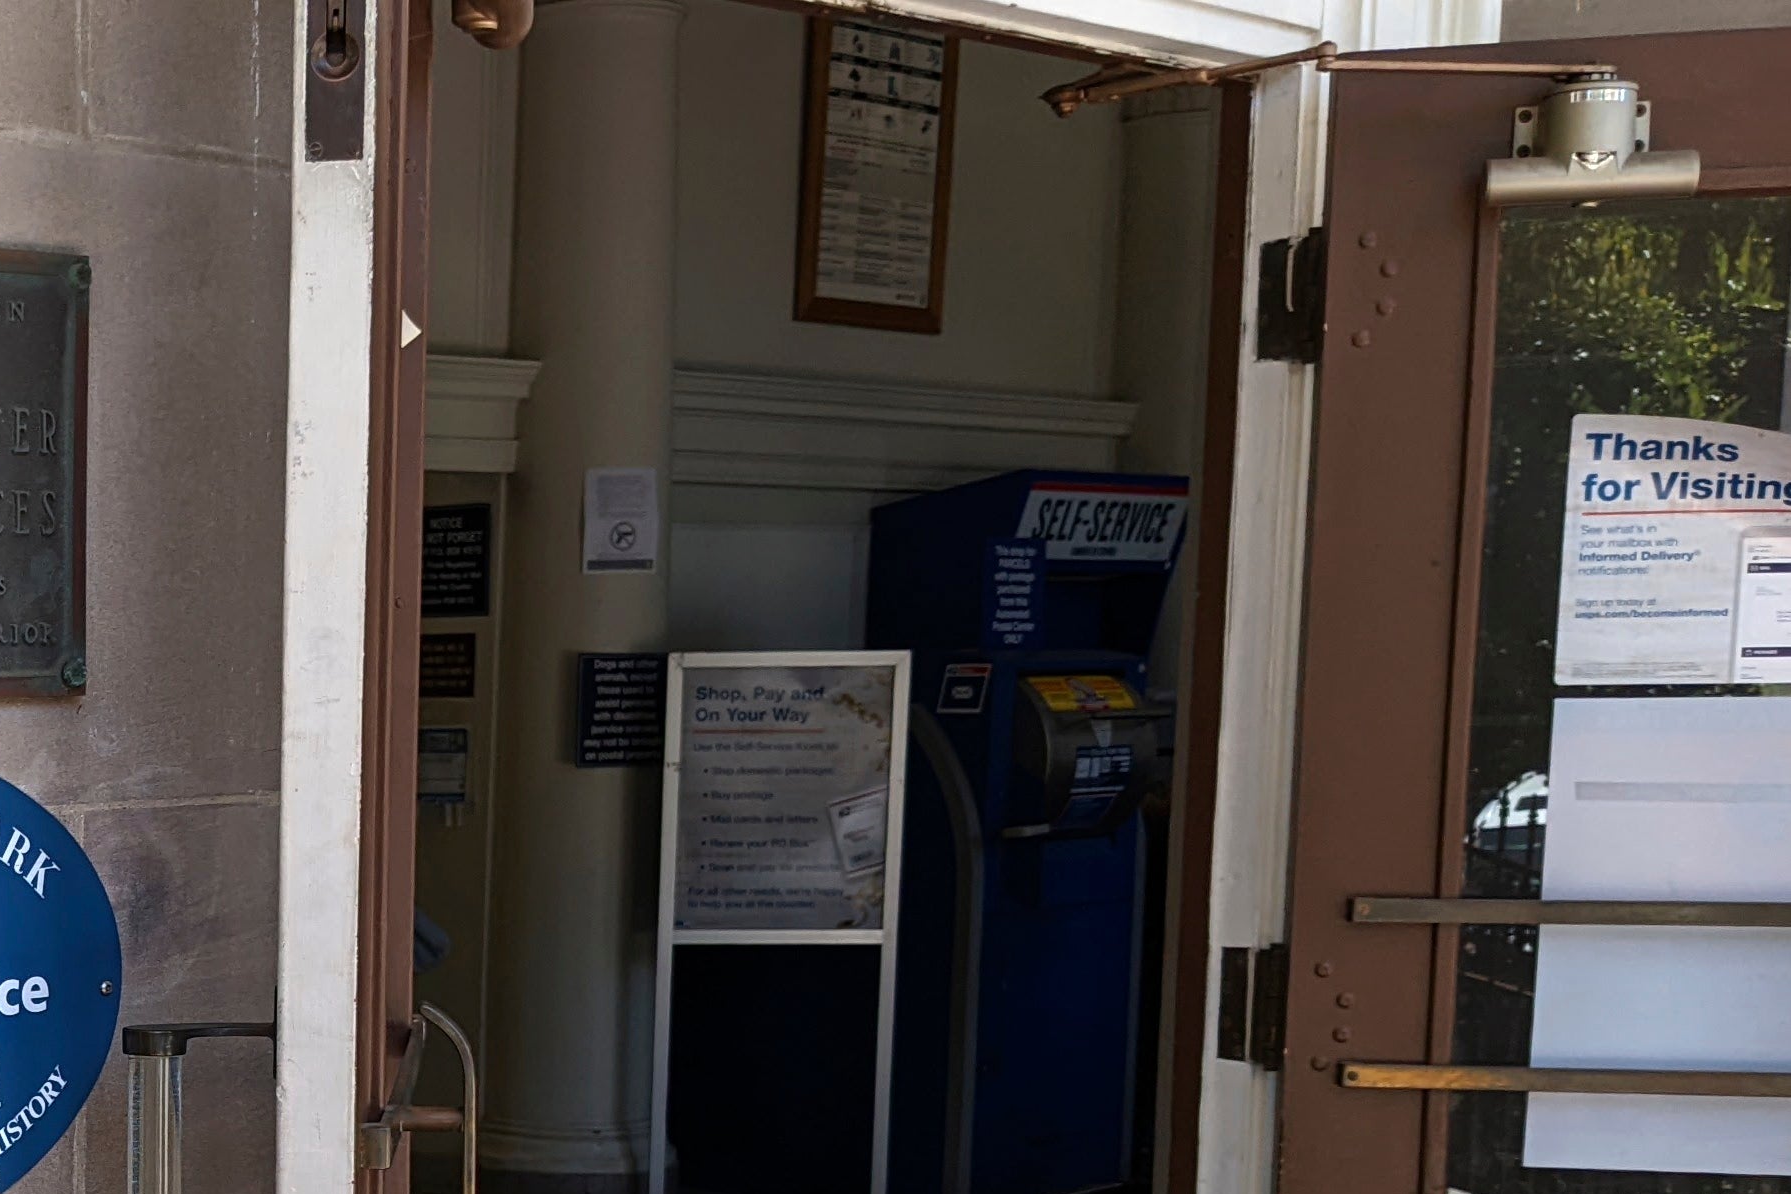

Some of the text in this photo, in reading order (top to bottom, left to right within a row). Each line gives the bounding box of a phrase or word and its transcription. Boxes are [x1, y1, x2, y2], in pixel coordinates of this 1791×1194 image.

[1585, 432, 1740, 463] Thanks
[1581, 473, 1641, 502] for
[1032, 498, 1176, 544] SELF-SERVICE
[1580, 524, 1658, 535] See what's in
[1580, 537, 1679, 550] your mailbox with
[1579, 551, 1638, 562] Informed
[1575, 599, 1598, 608] Sign
[1601, 599, 1614, 608] up
[1617, 599, 1645, 608] today
[593, 659, 616, 671] Dogs
[618, 660, 634, 669] and
[597, 685, 621, 695] those
[695, 686, 826, 704] Shop, Pay and
[593, 711, 611, 721] with
[695, 707, 811, 725] On Your Way
[584, 752, 596, 761] on
[711, 790, 731, 801] Buy
